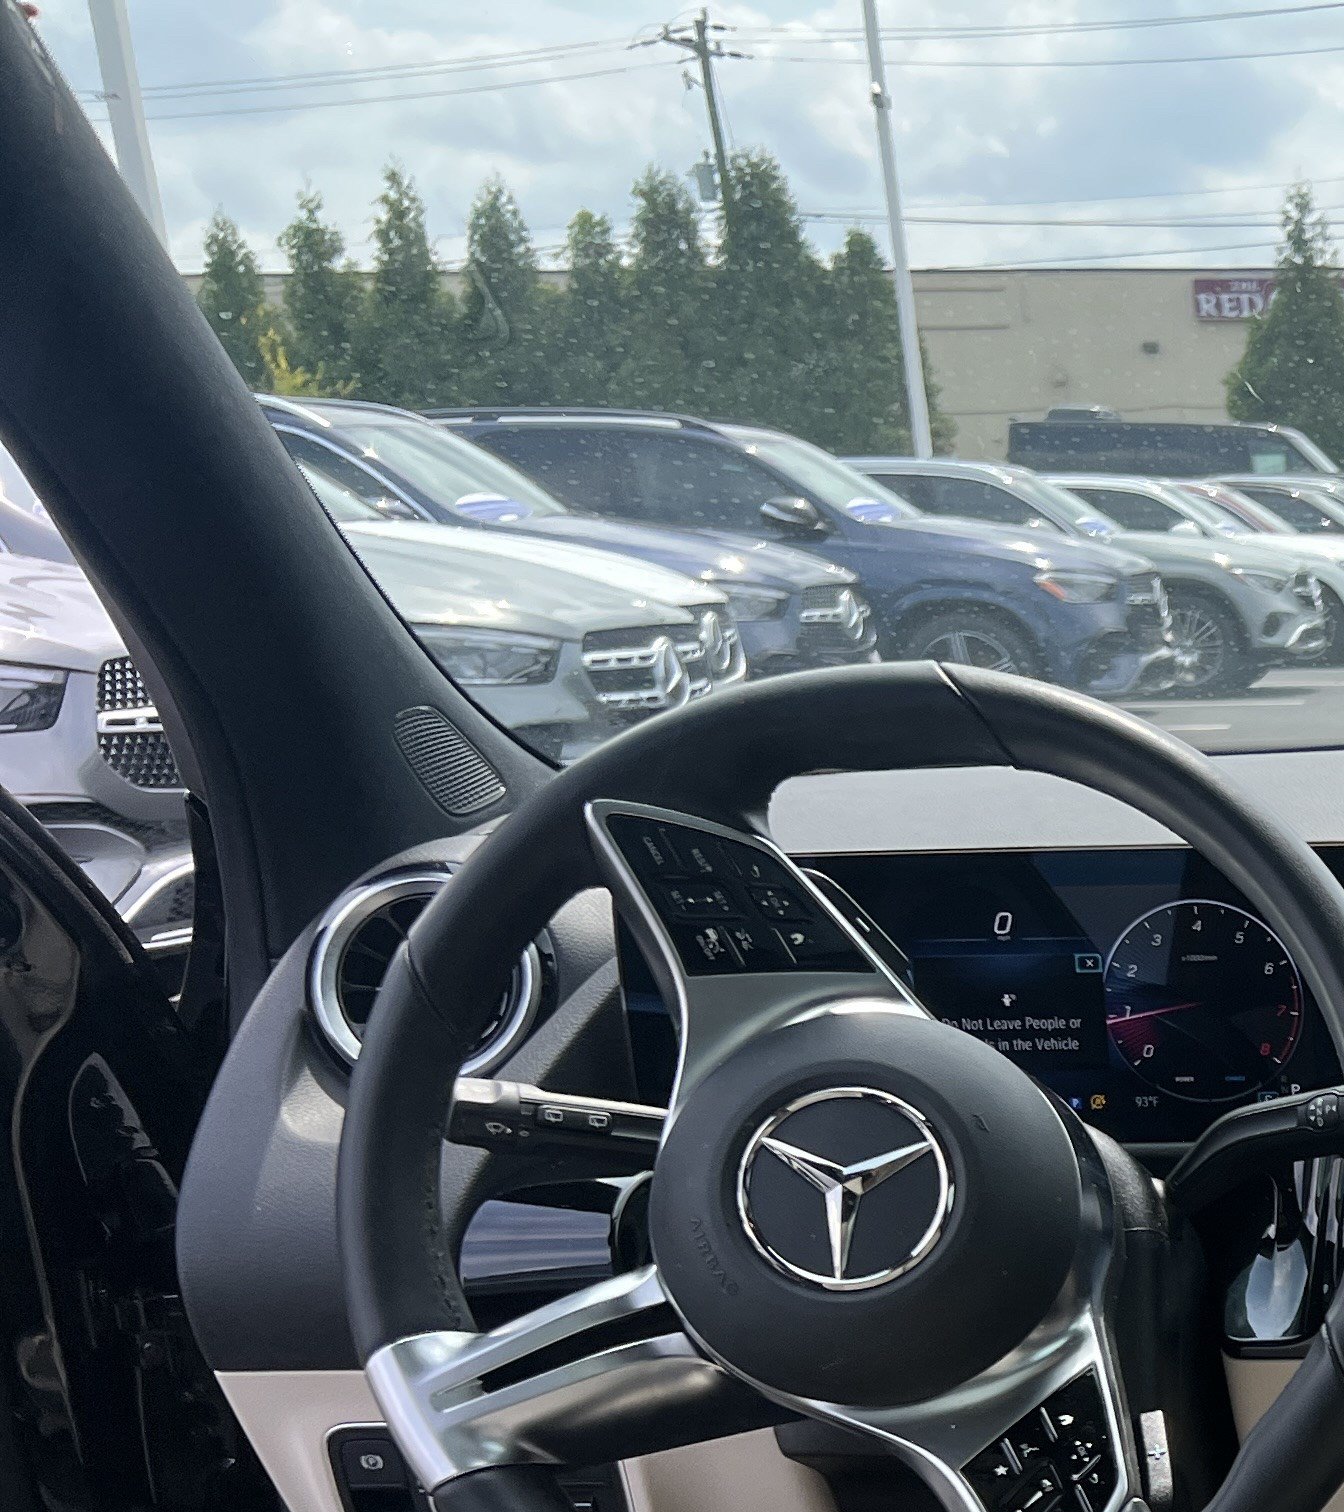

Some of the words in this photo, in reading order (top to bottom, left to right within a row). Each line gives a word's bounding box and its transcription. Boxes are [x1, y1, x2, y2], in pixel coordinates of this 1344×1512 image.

[993, 911, 1013, 934] 0
[1191, 920, 1202, 932] 4
[1151, 934, 1162, 946] 3
[1234, 932, 1245, 944] 5
[1127, 964, 1138, 978] 2
[1264, 962, 1274, 975] 6
[1125, 1005, 1132, 1019] 1
[1277, 1004, 1287, 1018] 7
[961, 1018, 983, 1031] Not
[986, 1018, 1022, 1030] Leave
[1025, 1016, 1066, 1032] People
[1069, 1018, 1082, 1029] or
[998, 1039, 1010, 1051] in
[1013, 1038, 1033, 1050] the
[1035, 1036, 1080, 1051] Vehicle
[1260, 1043, 1272, 1056] 8
[1143, 1044, 1155, 1058] 0
[1290, 1083, 1301, 1095] P
[690, 1218, 740, 1296] AIRBAG
